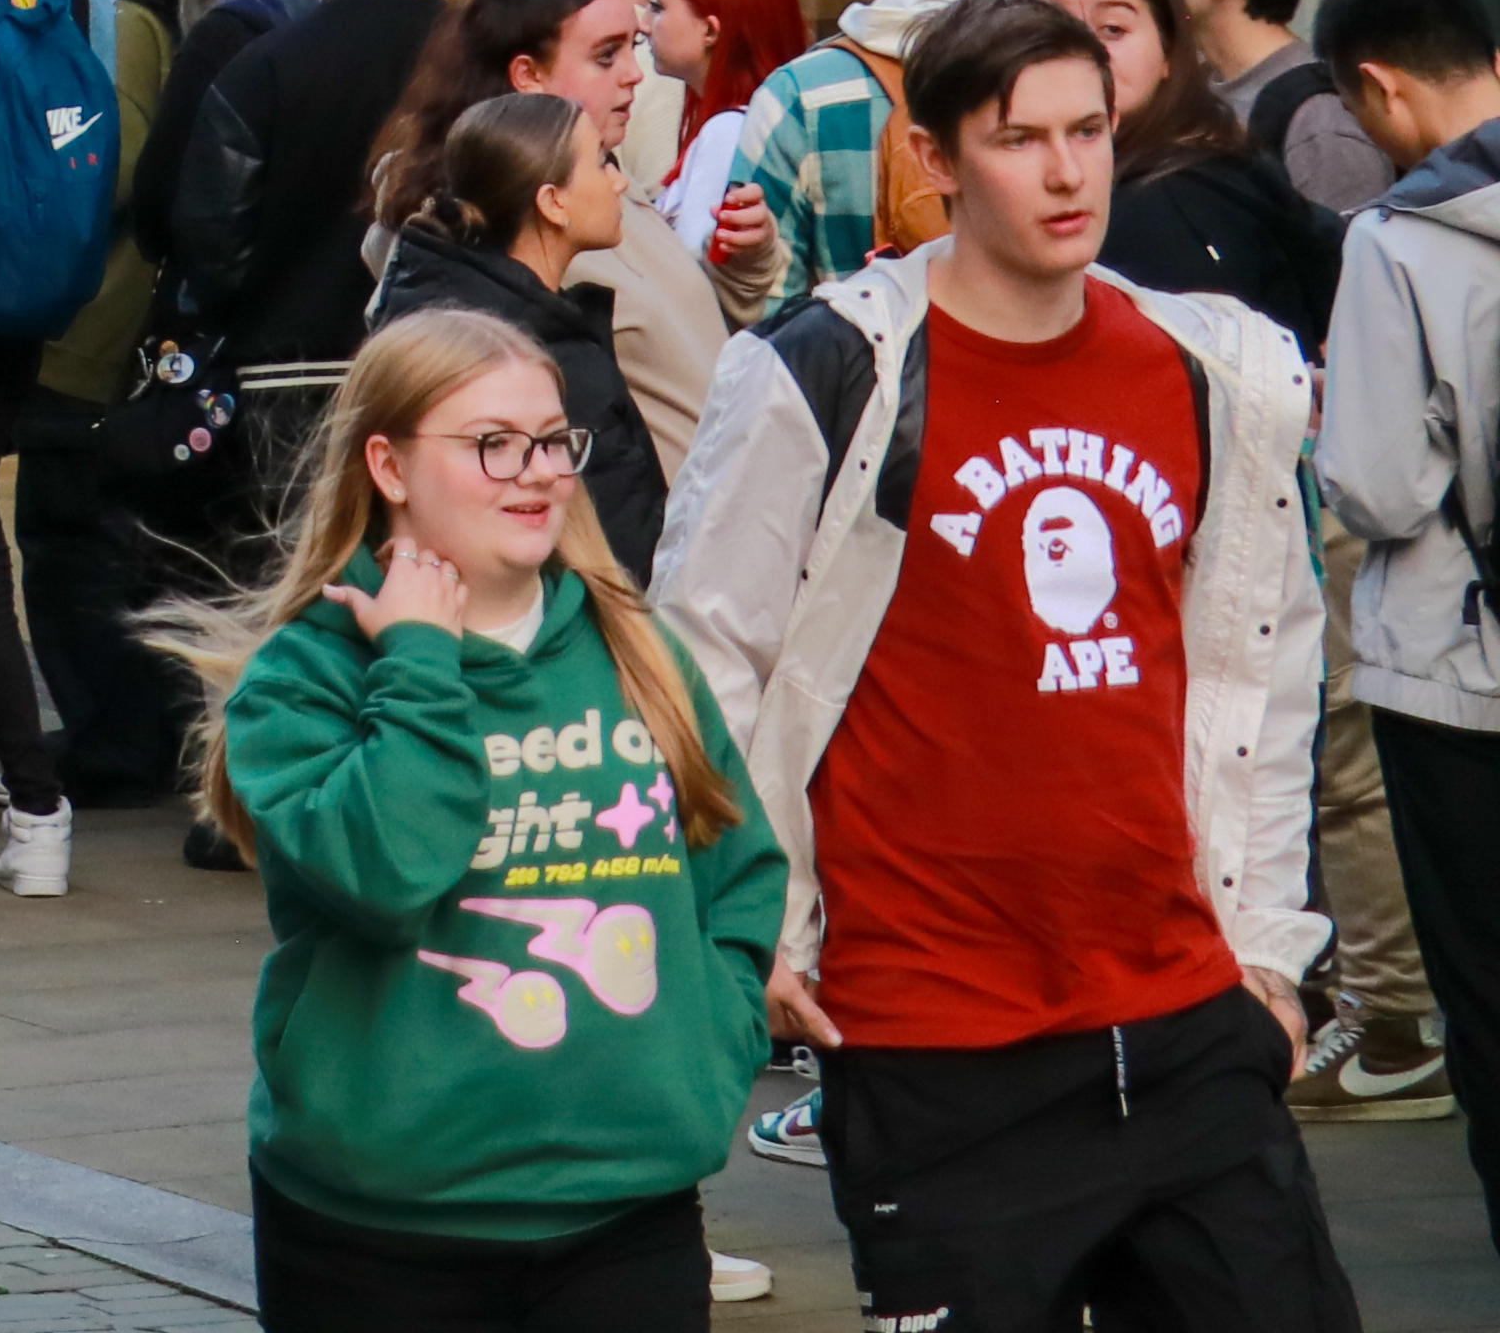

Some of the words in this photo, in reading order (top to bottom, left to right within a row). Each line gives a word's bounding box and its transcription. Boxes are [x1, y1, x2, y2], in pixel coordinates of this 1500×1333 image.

[953, 427, 1183, 550] BATHING
[929, 511, 983, 557] A
[1037, 636, 1140, 692] APE
[484, 708, 603, 777] eed
[612, 718, 666, 765] o
[469, 790, 593, 870] ght
[544, 861, 588, 883] 792
